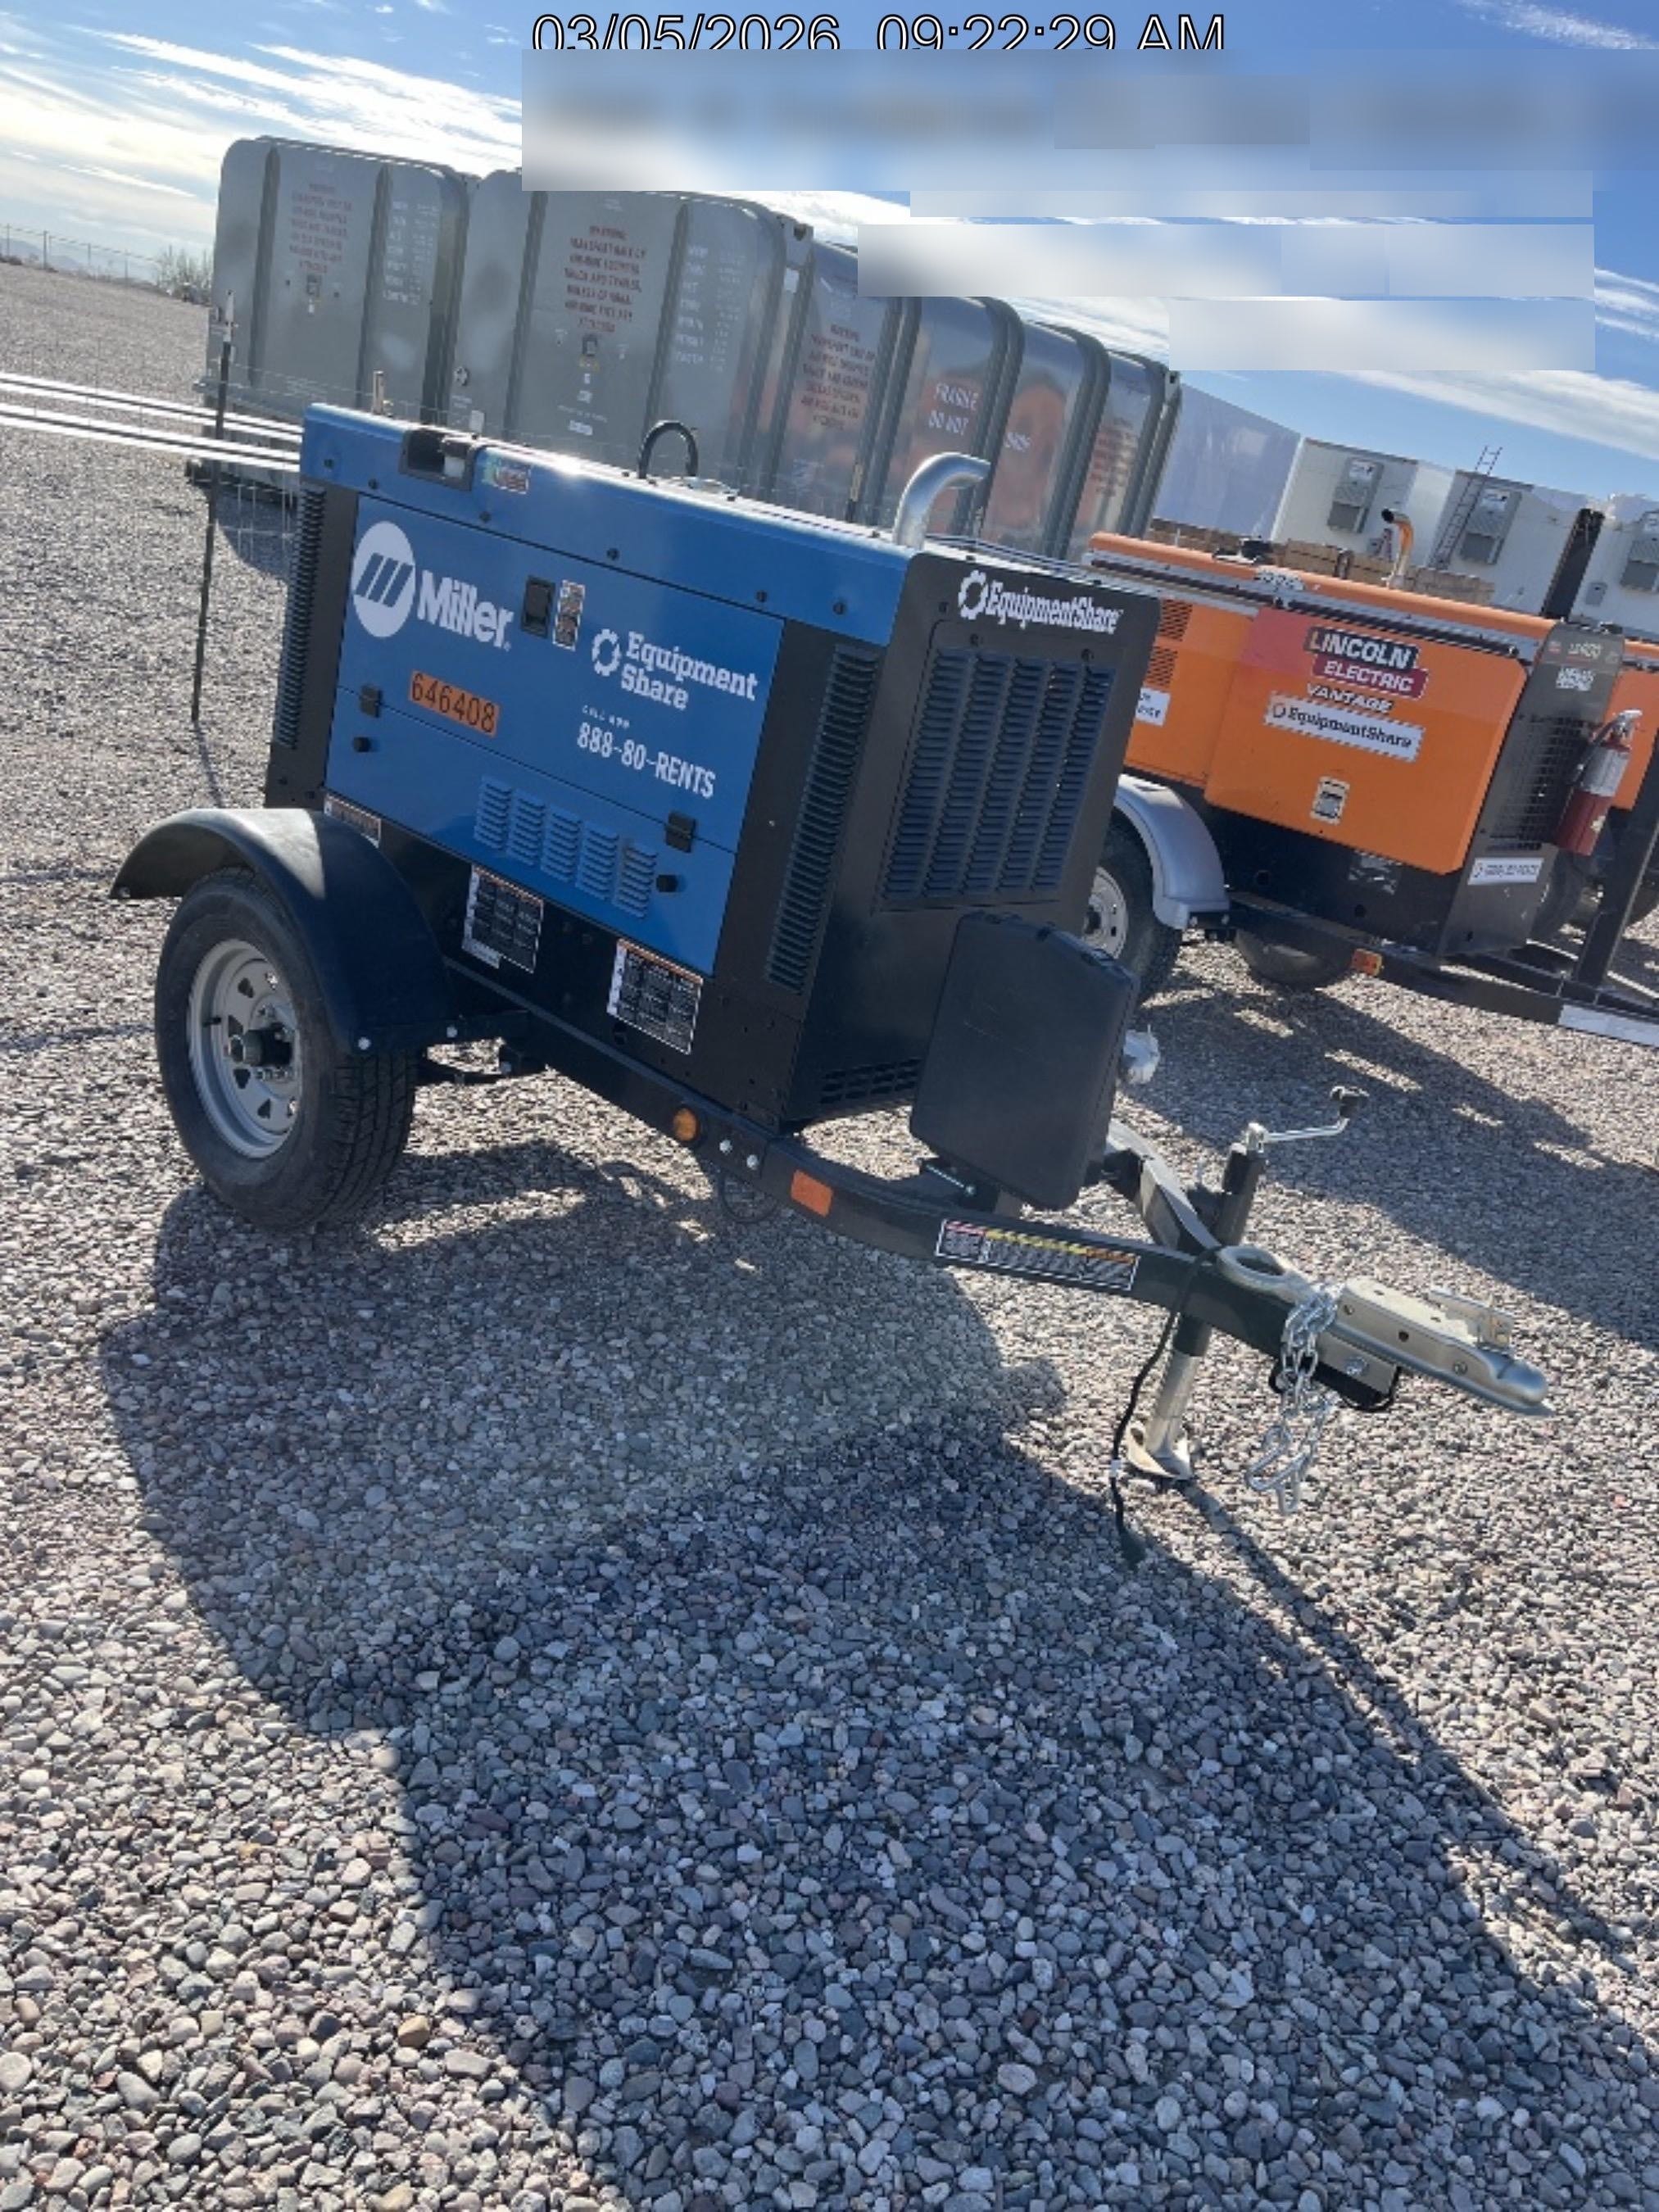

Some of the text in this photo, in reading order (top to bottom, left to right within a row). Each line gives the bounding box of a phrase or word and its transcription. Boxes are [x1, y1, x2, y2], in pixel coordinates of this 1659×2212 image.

[417, 569, 514, 648] Miller
[986, 579, 1119, 635] EquipmentShare
[626, 631, 759, 701] Equipment
[1310, 630, 1412, 670] LINCOLN
[621, 663, 690, 710] Share
[1307, 682, 1394, 714] VANTAGE
[1323, 660, 1415, 692] ELECTRIC
[411, 672, 496, 733] 646408
[1288, 705, 1412, 749] EquipmentShare
[577, 722, 716, 800] 888-80-RENTS
